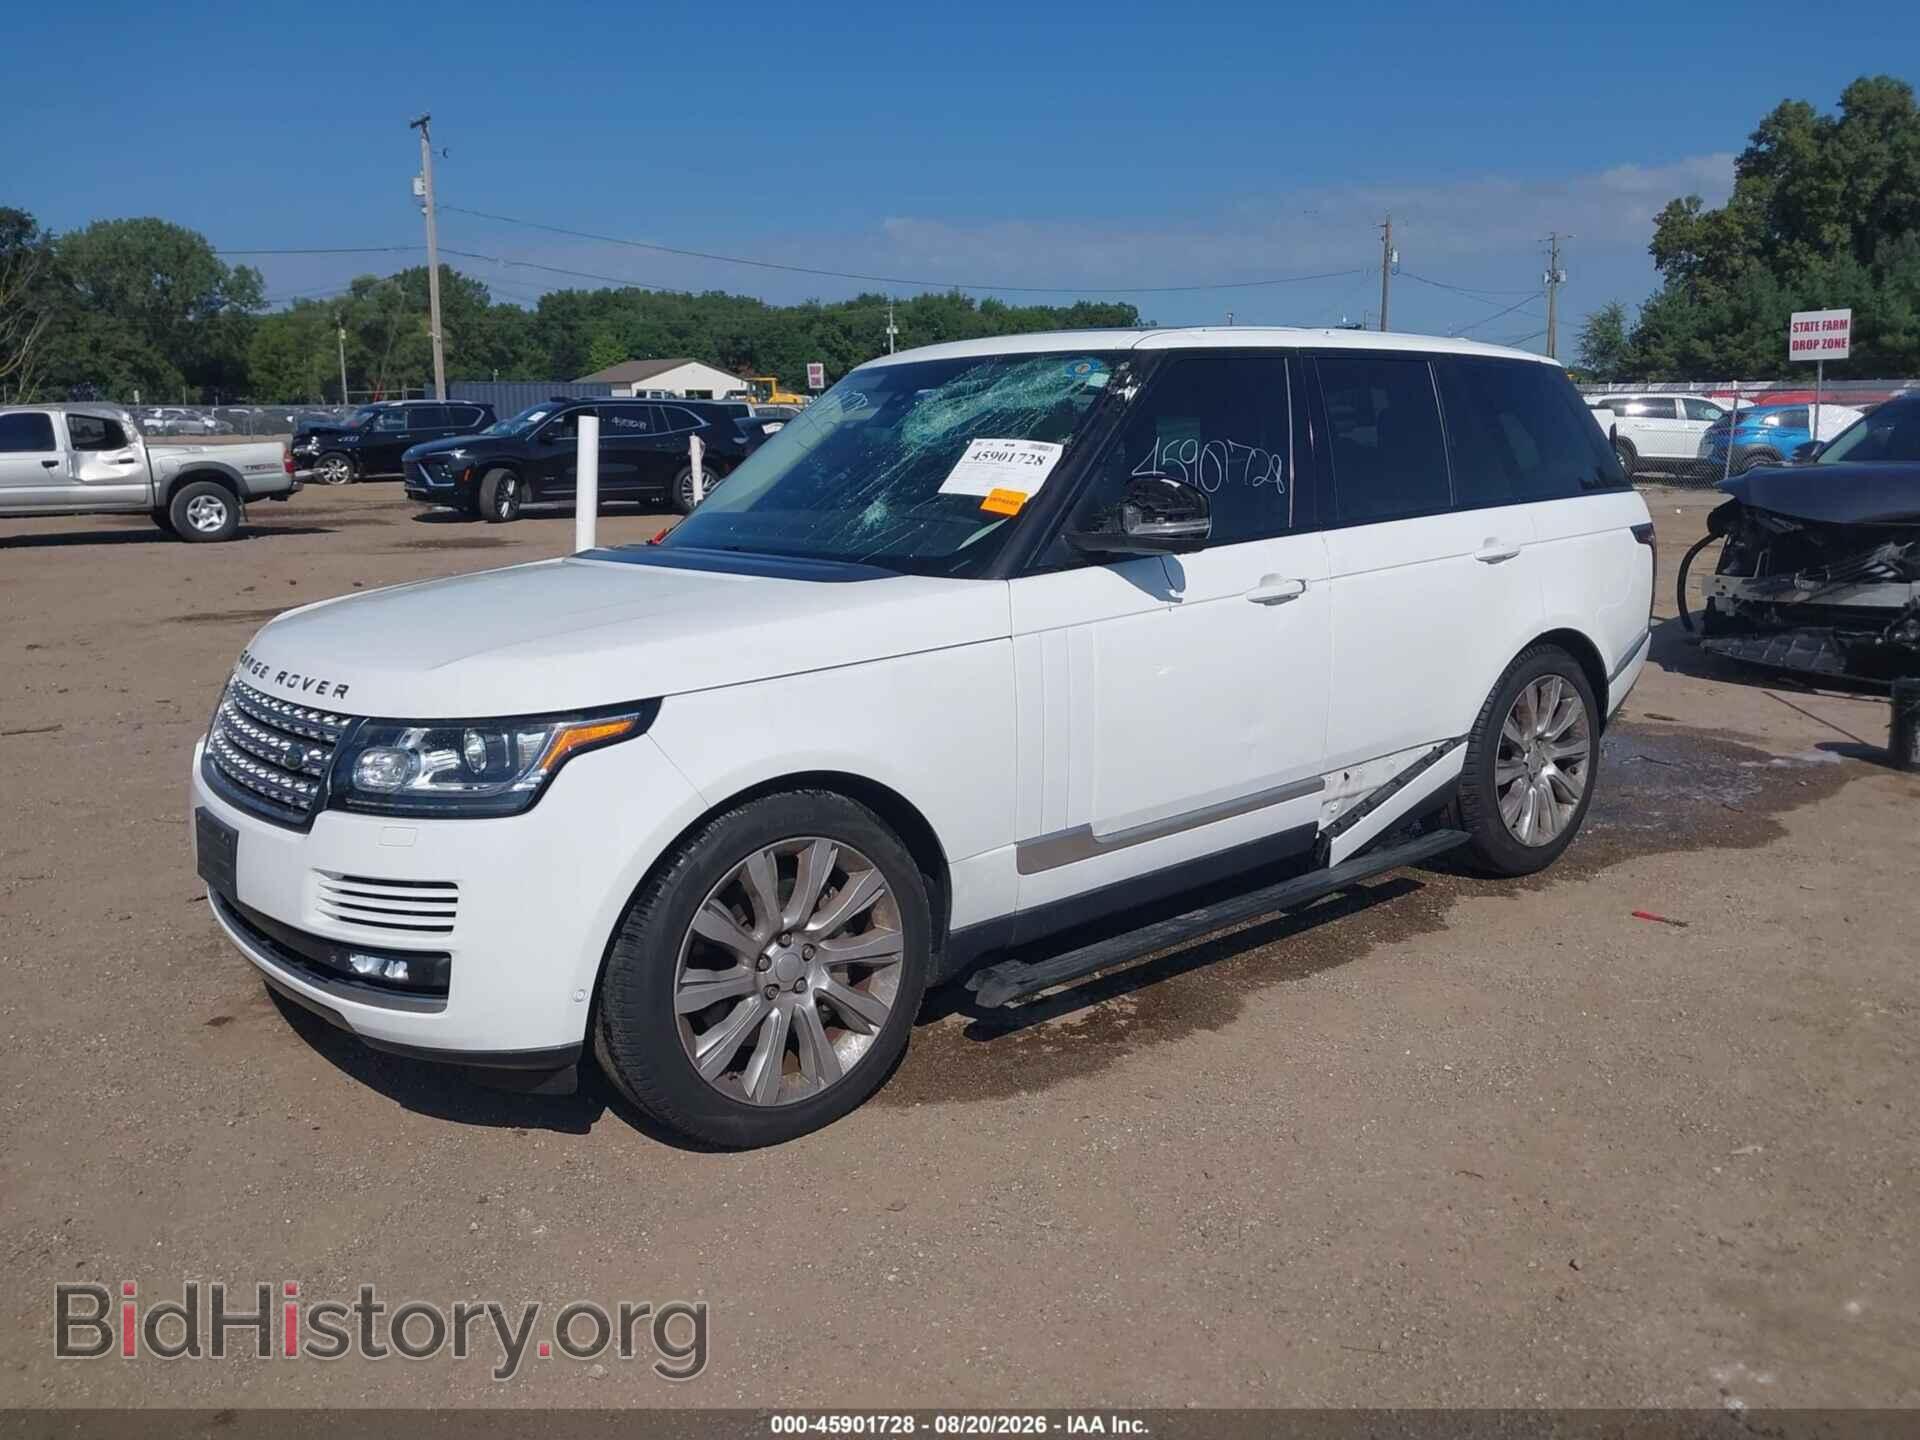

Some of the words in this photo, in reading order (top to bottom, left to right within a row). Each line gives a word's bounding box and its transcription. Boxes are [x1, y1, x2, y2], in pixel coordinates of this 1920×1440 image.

[1792, 321, 1820, 333] STATE
[1822, 319, 1848, 331] FARM
[1791, 339, 1820, 351] DROP
[1822, 337, 1847, 349] ZONE
[971, 450, 1046, 467] 45901728
[274, 670, 350, 699] ROVER
